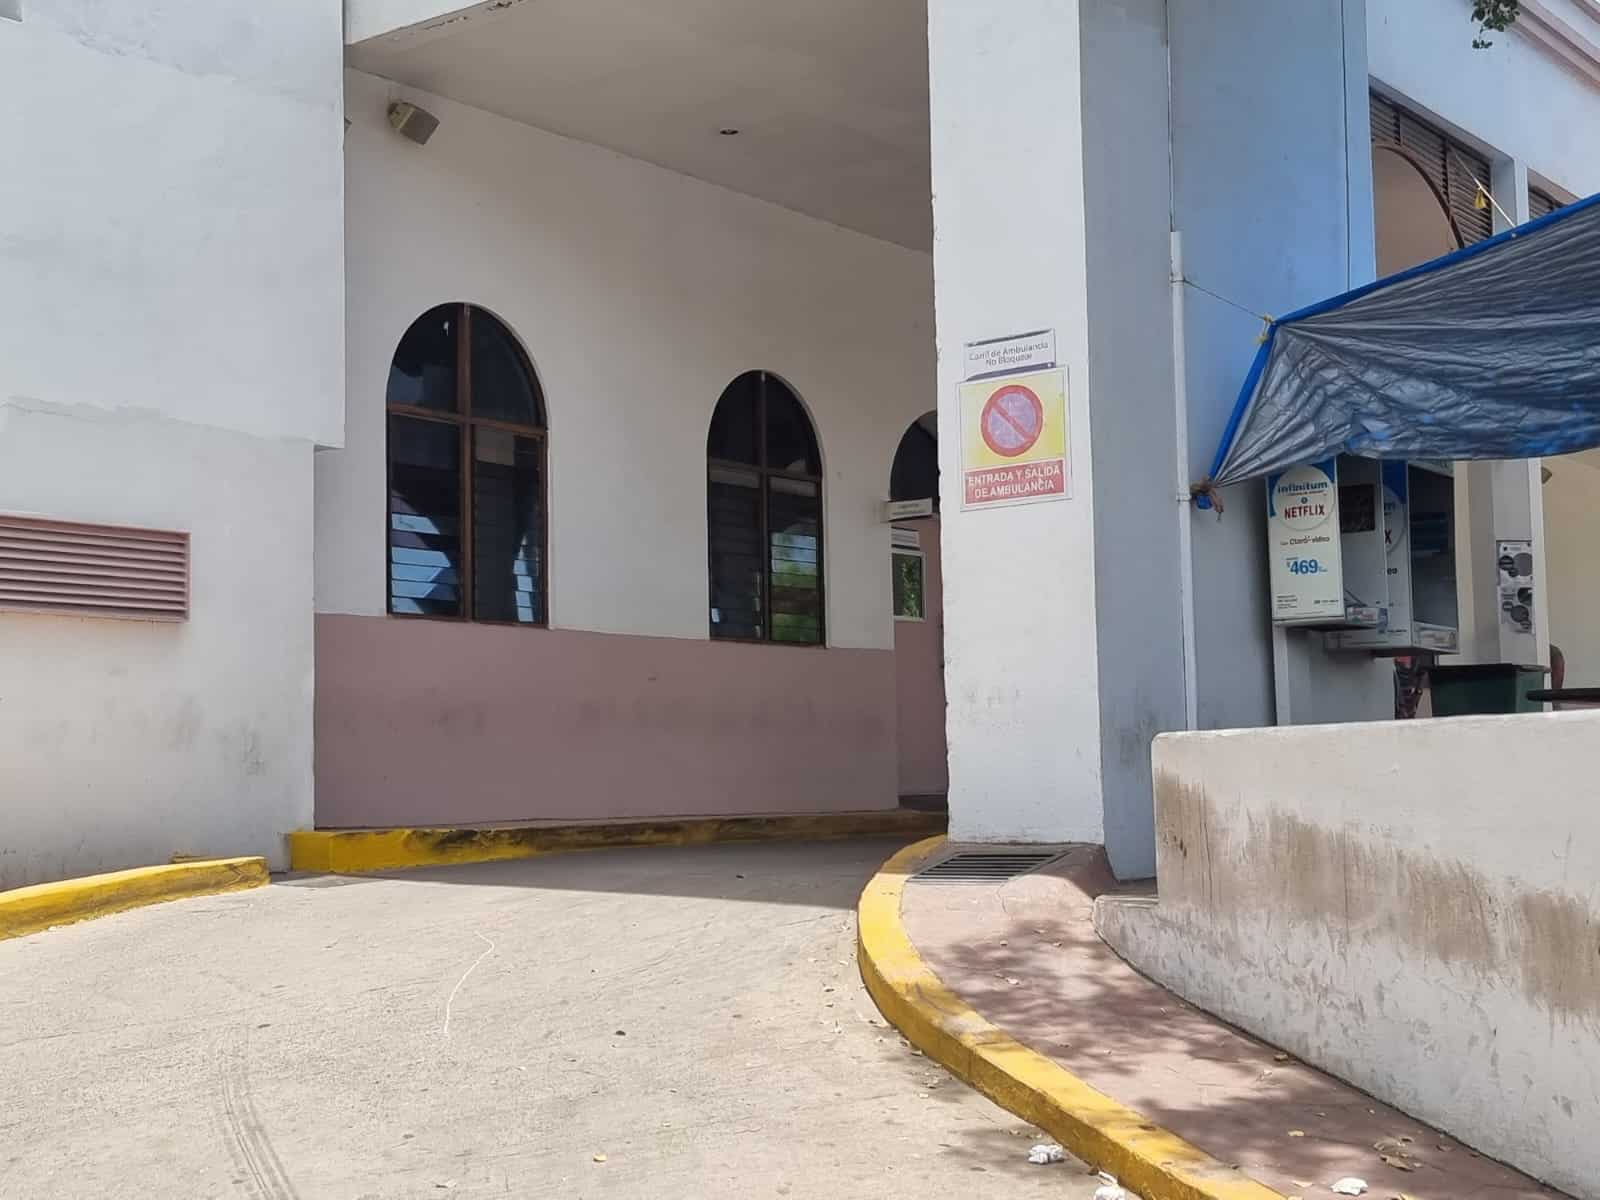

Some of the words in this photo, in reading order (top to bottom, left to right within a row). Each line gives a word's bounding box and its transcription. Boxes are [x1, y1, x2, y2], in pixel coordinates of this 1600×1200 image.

[969, 350, 990, 361] Carril
[991, 350, 1001, 358] de
[1003, 341, 1049, 356] Ambulancia
[998, 353, 1033, 364] Bloquear
[968, 471, 1014, 487] ENTRADA
[1015, 469, 1023, 480] Y
[1024, 464, 1061, 479] SALIDA
[974, 487, 989, 498] DE
[990, 478, 1055, 497] AMBULANCIA
[1278, 481, 1328, 494] infinitum
[1284, 504, 1325, 520] NETFLIX
